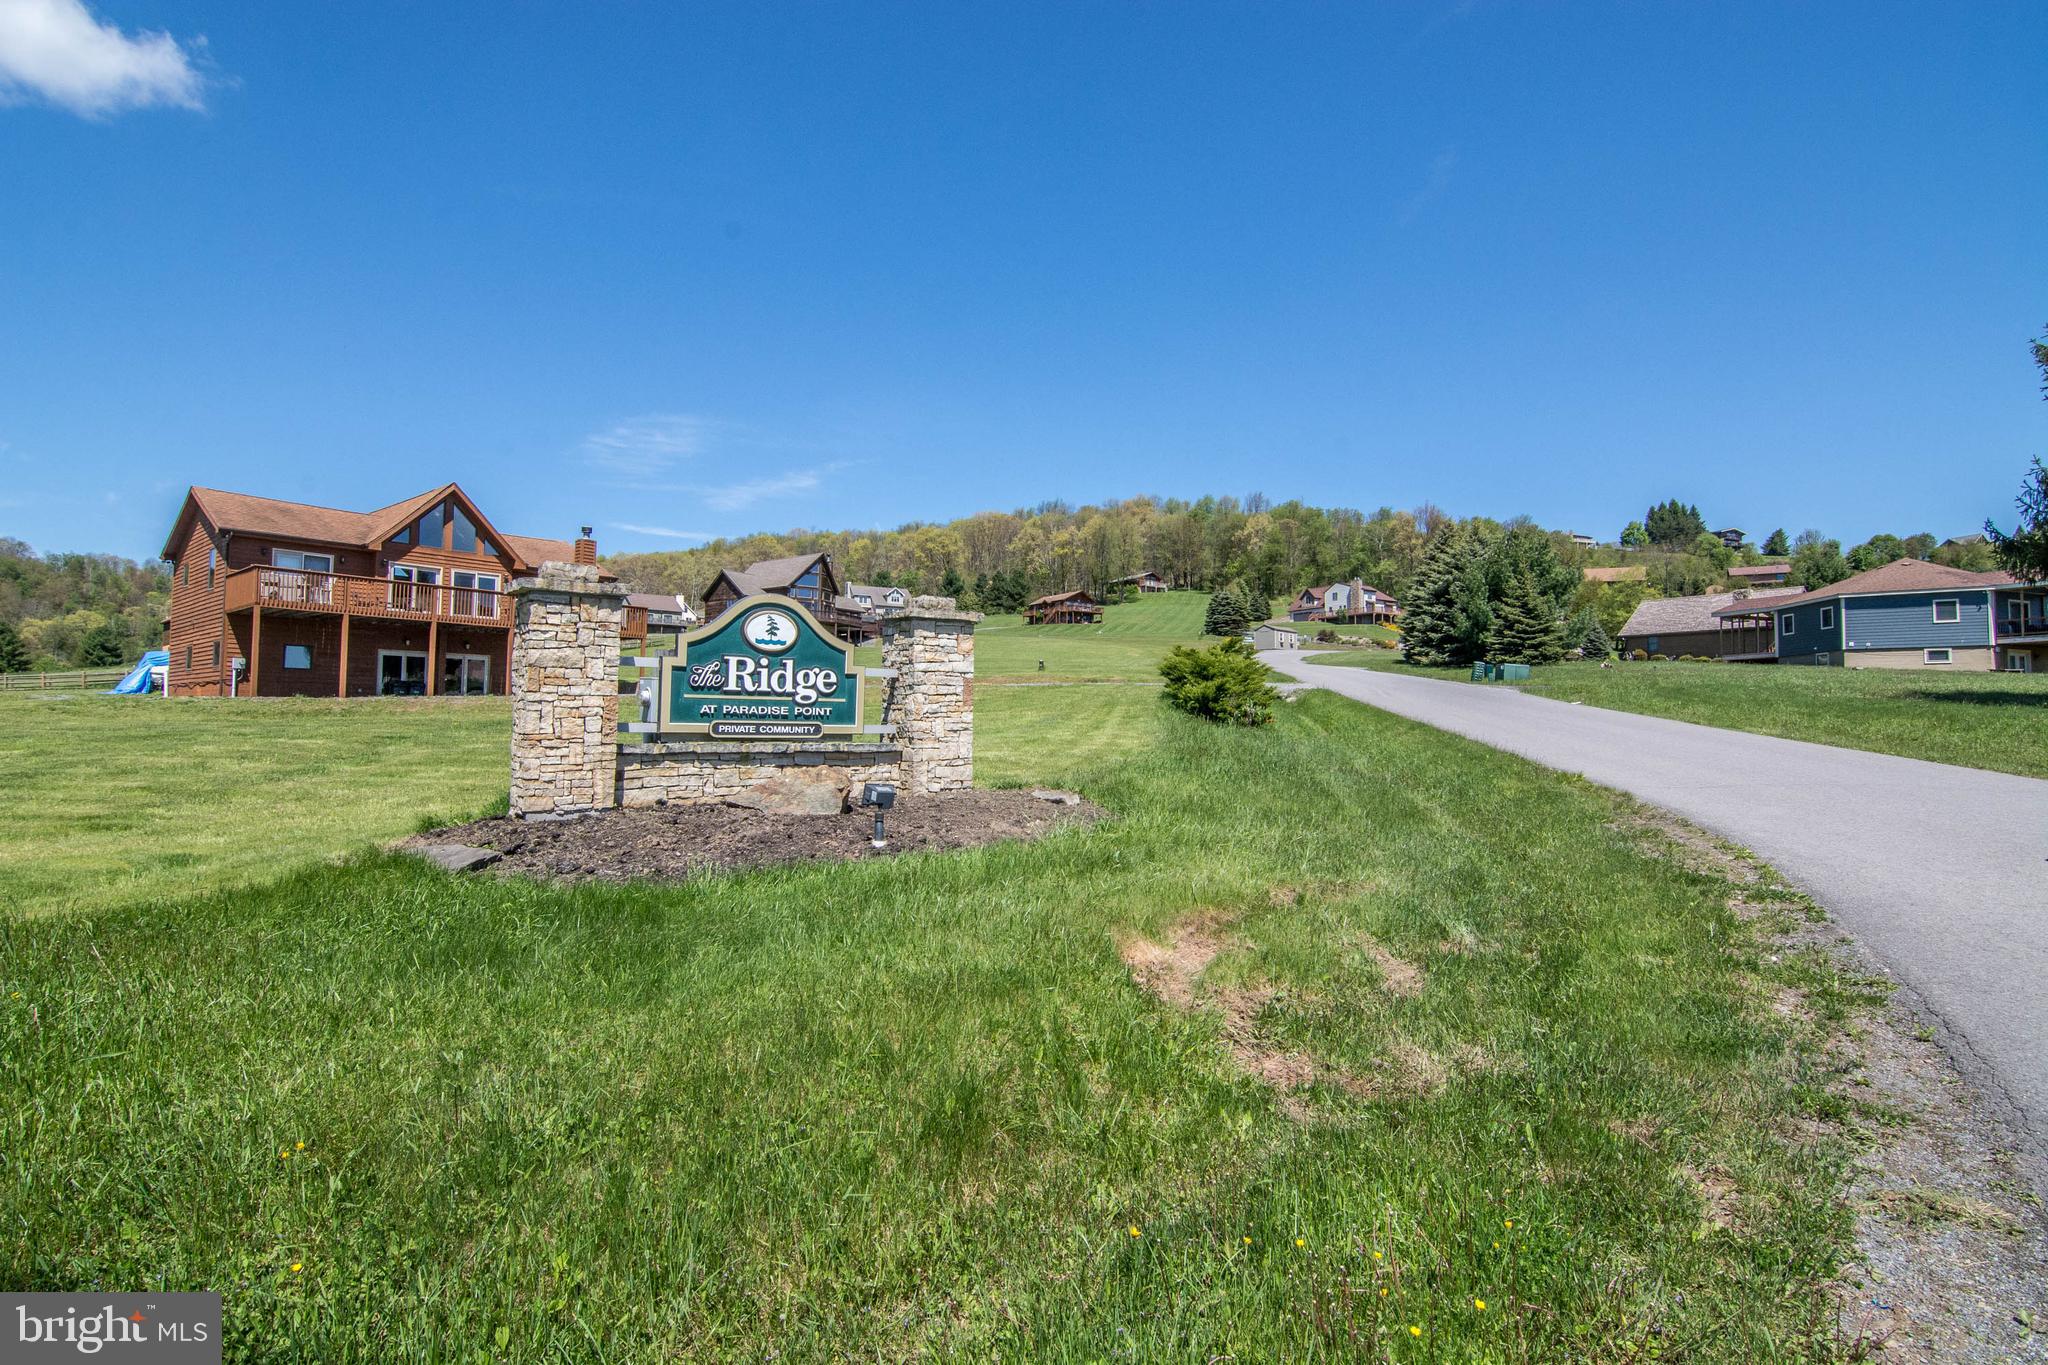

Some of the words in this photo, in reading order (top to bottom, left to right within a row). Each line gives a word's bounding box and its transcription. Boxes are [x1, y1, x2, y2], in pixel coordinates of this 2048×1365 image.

[689, 661, 724, 688] The
[722, 655, 838, 704] Ridge
[700, 705, 717, 715] AT
[722, 705, 789, 716] PARADISE
[794, 706, 833, 717] POINT
[718, 725, 756, 734] PRIVATE
[759, 725, 815, 735] COMMUNITY
